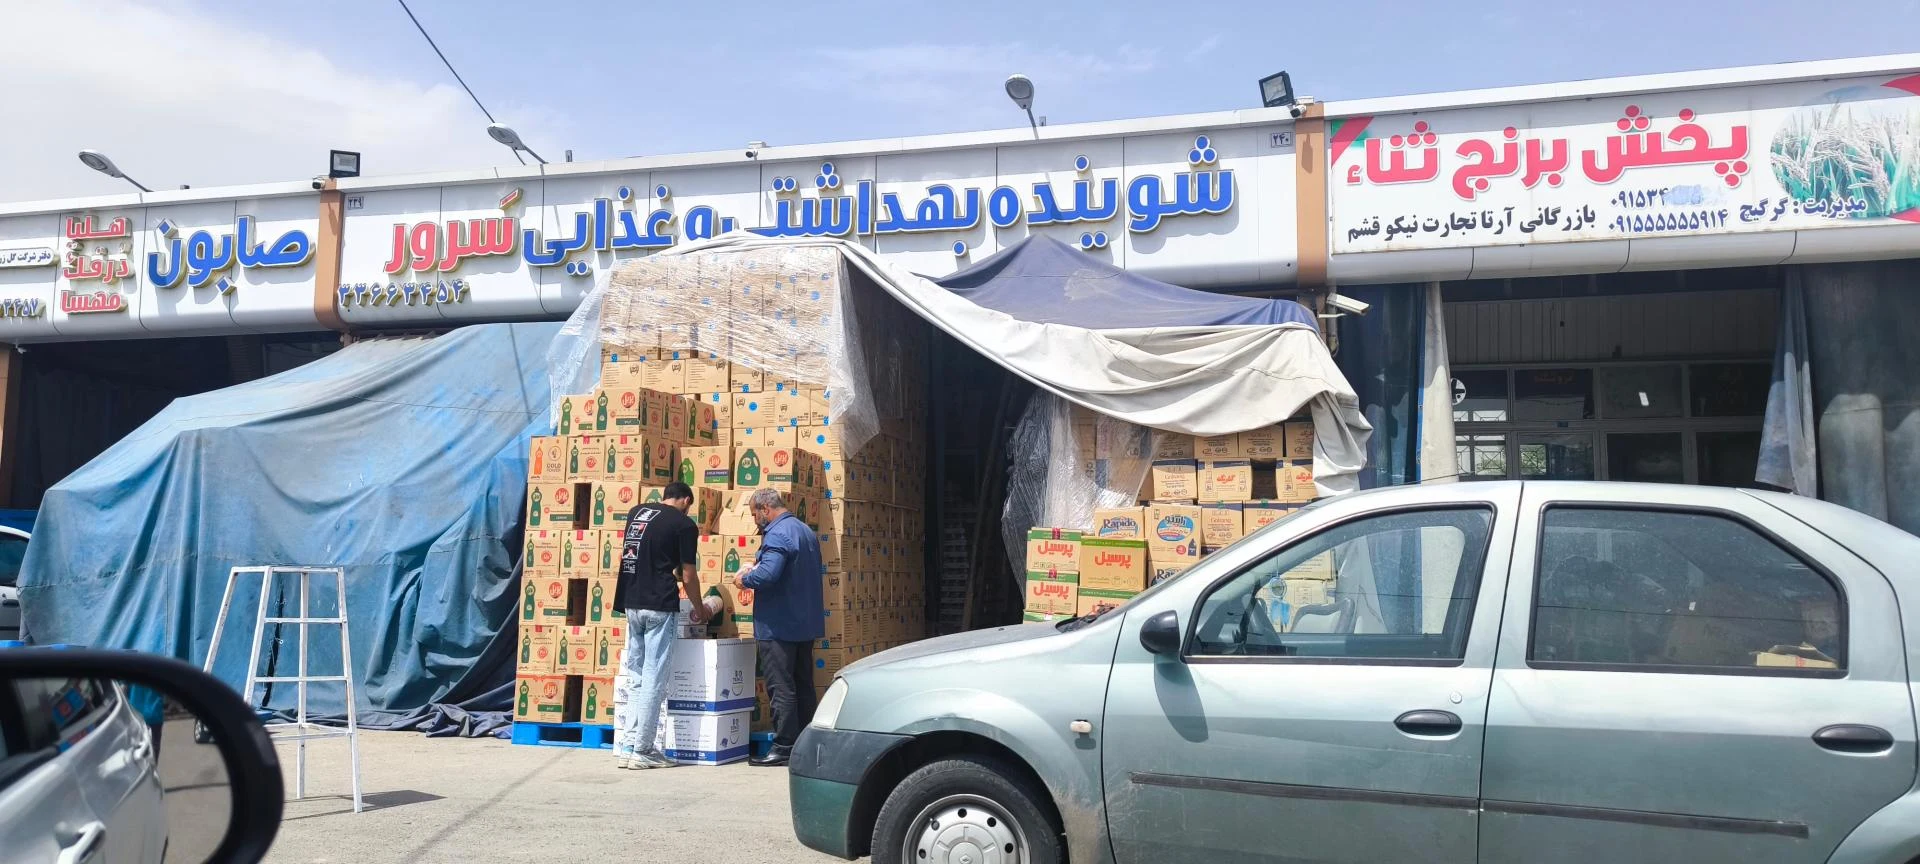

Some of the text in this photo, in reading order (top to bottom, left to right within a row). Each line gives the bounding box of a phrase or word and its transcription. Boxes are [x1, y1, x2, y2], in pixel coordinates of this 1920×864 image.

[1347, 104, 1749, 200] پخش برنج ثناء
[989, 135, 1235, 250] شوینده
[1803, 197, 1866, 218] مدیریت
[523, 184, 675, 276] غذایی
[1348, 204, 1596, 243] بازرگانی آرتا تجارت نیکو قشم
[17, 252, 36, 263] شرکت
[147, 215, 311, 296] صابون
[61, 290, 121, 313] مهسا
[338, 279, 464, 305] ۳۳۶۶۳۴۵۴
[1103, 518, 1136, 530] Rapido
[1037, 540, 1074, 558] پرسیل
[1094, 551, 1132, 569] پرسیل
[1034, 581, 1070, 600] پرسیل
